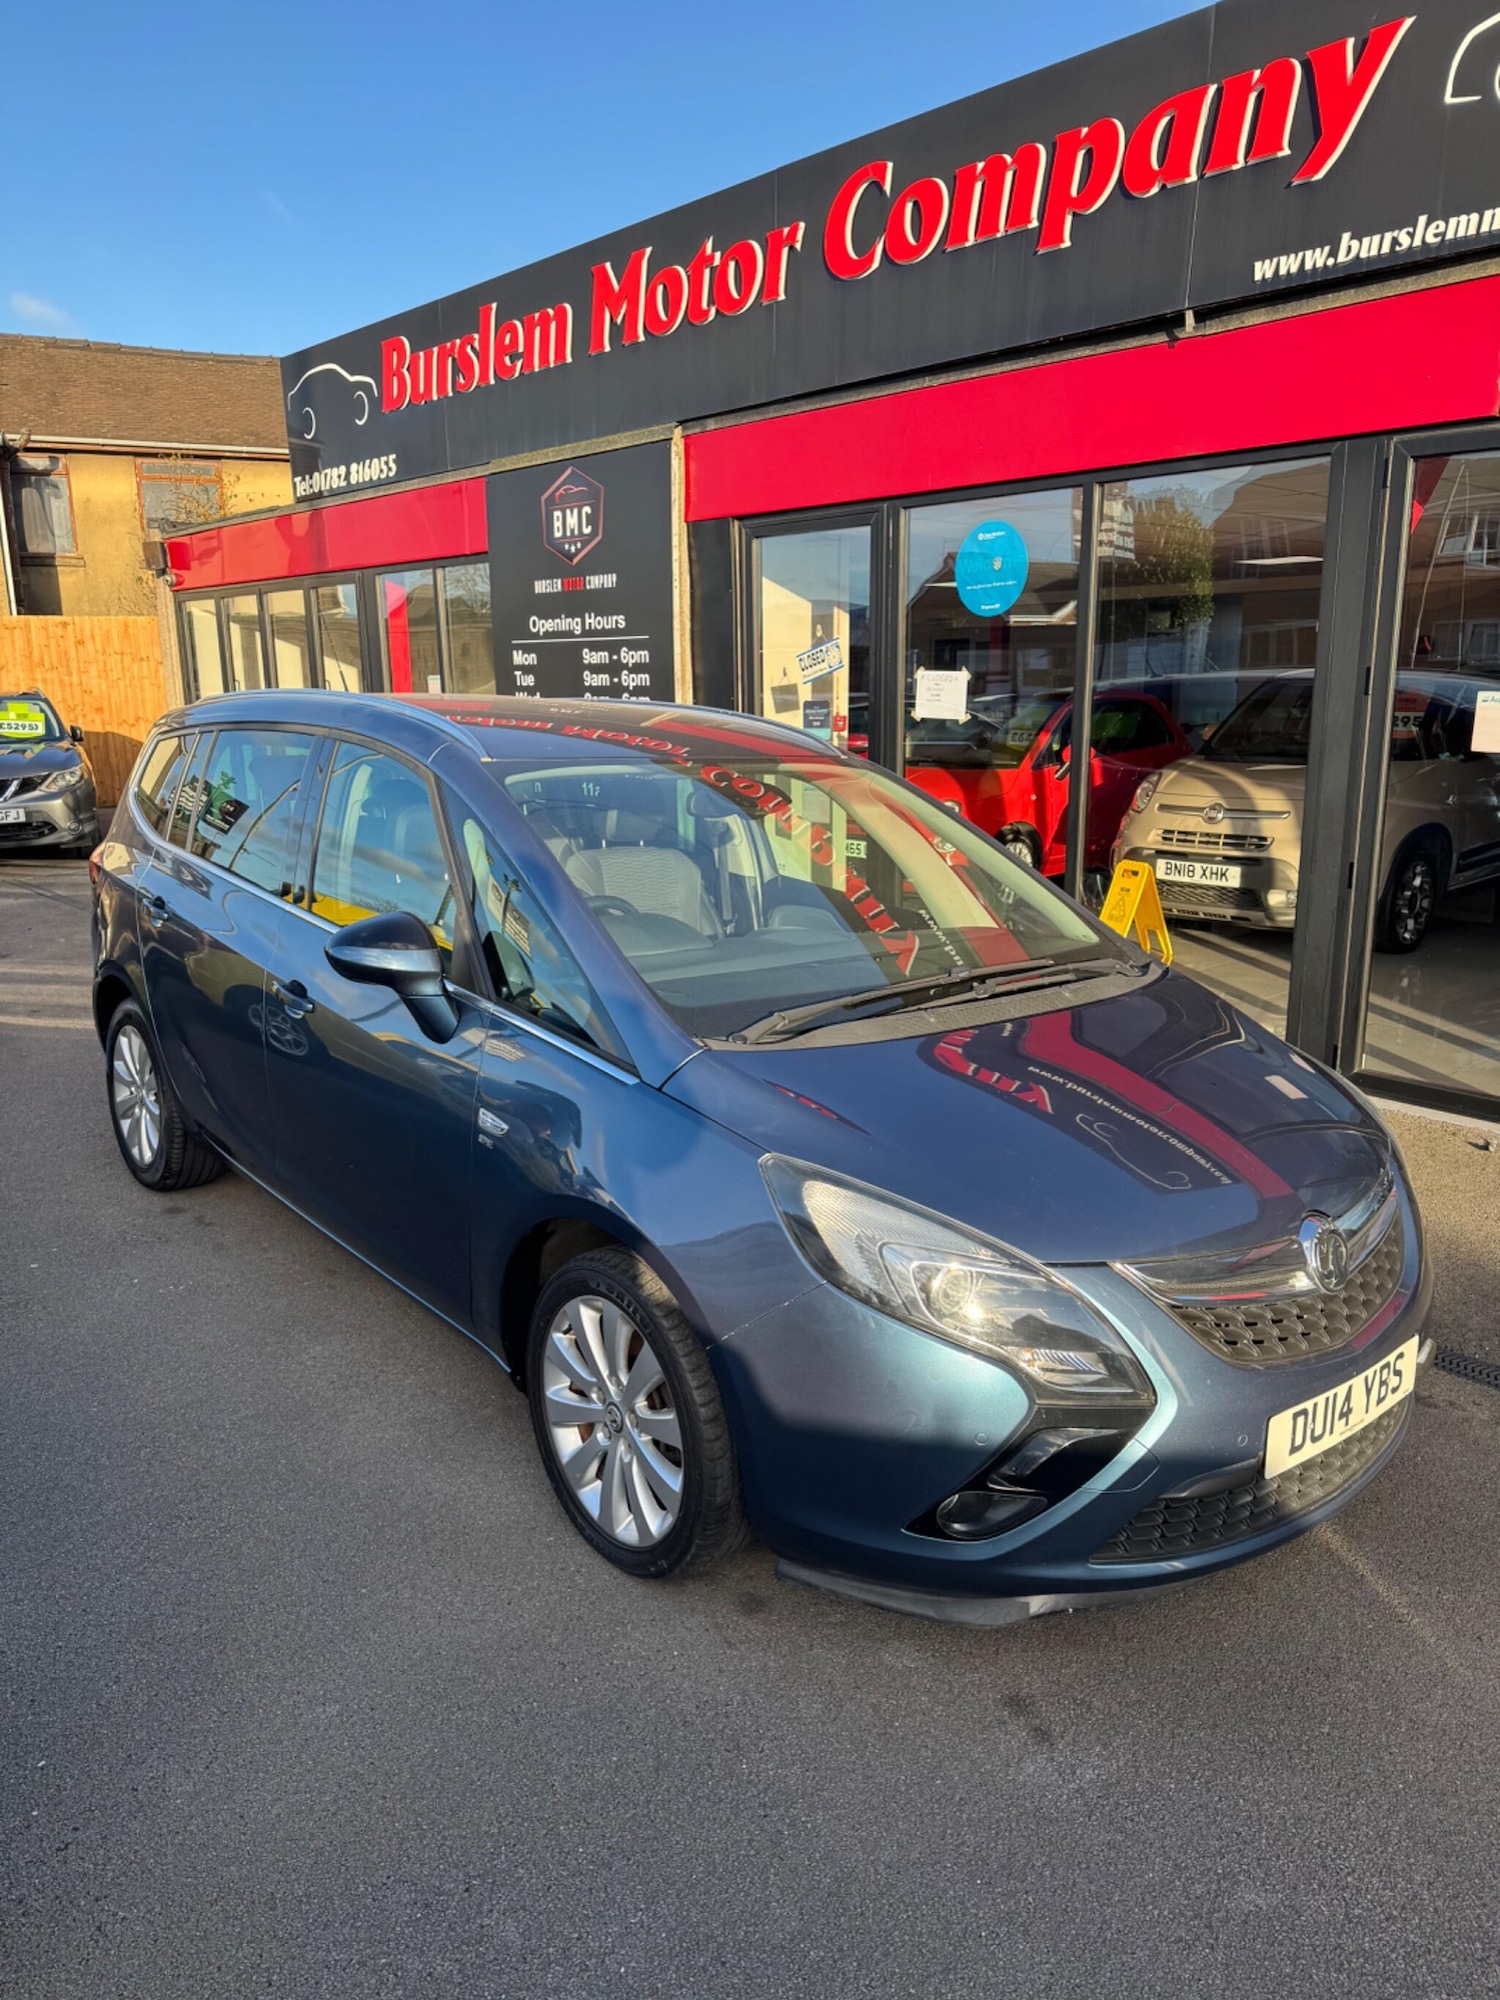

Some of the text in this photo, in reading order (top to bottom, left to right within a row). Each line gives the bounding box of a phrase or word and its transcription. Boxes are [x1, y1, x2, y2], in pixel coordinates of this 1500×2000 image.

[381, 15, 1416, 413] Burslem Motor Company
[294, 453, 397, 497] Tel:01782 816055
[553, 506, 592, 538] BMC
[529, 612, 626, 636] Opening Hours
[512, 650, 537, 665] Mon
[582, 648, 610, 664] 9am
[620, 647, 649, 667] 6pm
[514, 671, 535, 686] Tue
[583, 670, 610, 686] 9am
[621, 670, 650, 690] 6pm
[1164, 861, 1229, 882] BN18 XHK
[1288, 1351, 1405, 1457] DU14 YBS
